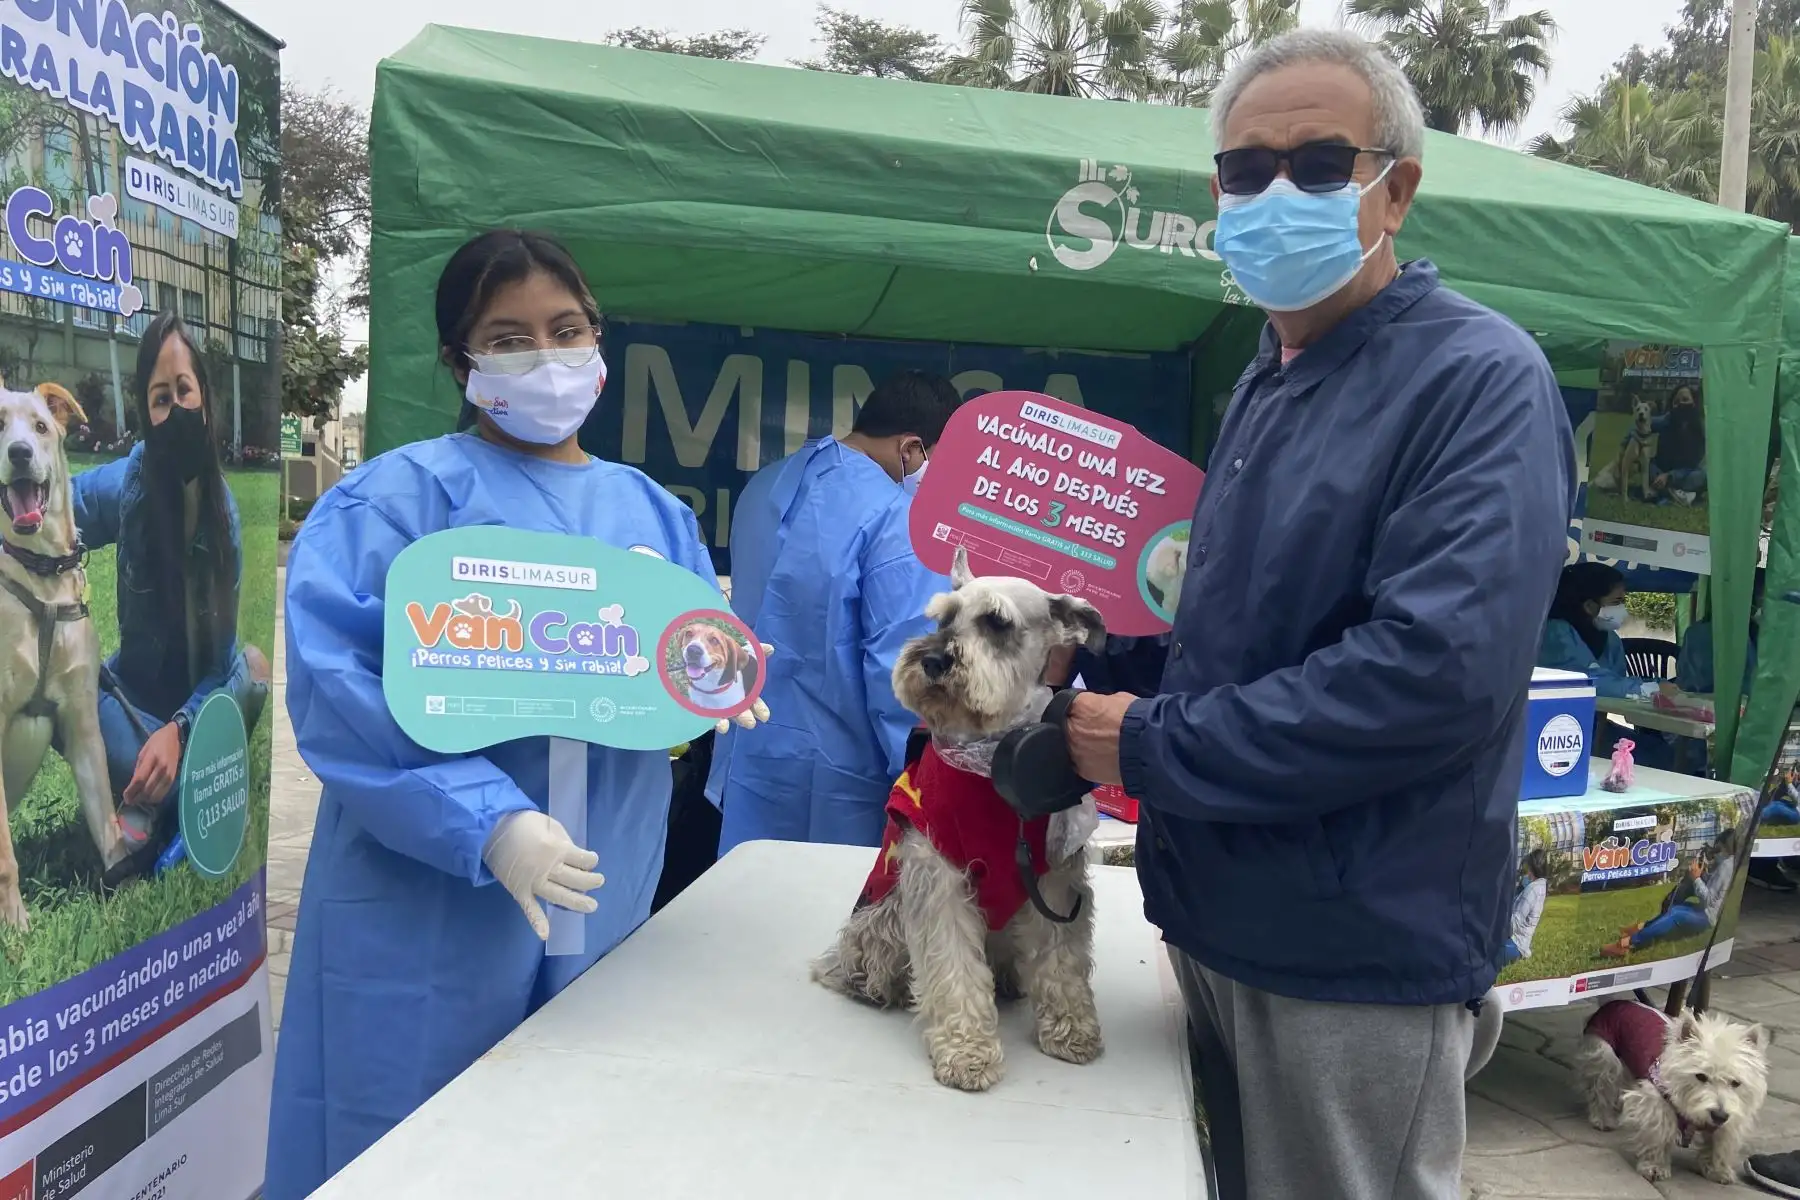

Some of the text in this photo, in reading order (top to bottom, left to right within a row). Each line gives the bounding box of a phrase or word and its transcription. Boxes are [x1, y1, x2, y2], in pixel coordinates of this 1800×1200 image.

[69, 58, 116, 115] LA
[123, 80, 241, 192] RABIA
[7, 187, 132, 283] Can
[71, 282, 116, 309] rabia!
[977, 413, 1166, 495] VACÚNALO UNA VEZ
[977, 446, 1139, 519] AL AÑO DESPUÉS
[973, 476, 1126, 548] DE LOS 3 MESES
[405, 602, 639, 657] Van Can
[412, 649, 470, 667] ¡Perros
[477, 653, 533, 670] felices
[581, 659, 622, 674] rabia!
[1540, 734, 1581, 750] MINSA
[192, 770, 204, 784] Para
[205, 761, 216, 776] más
[213, 765, 239, 792] GRATIS
[205, 788, 245, 827] 113 SALUD
[1583, 839, 1677, 871] Van Can
[56, 949, 178, 1031] vacunándolo
[183, 936, 212, 962] una
[217, 916, 237, 942] vez
[238, 901, 245, 927] al
[49, 1043, 79, 1077] los
[84, 1028, 96, 1055] 3
[102, 996, 159, 1045] meses
[164, 980, 184, 1007] de
[188, 948, 242, 993] nacido.
[155, 1040, 223, 1094] Dirección de Redes
[194, 1067, 204, 1079] de
[205, 1047, 224, 1072] Salud
[155, 1093, 186, 1124] Lima Sur
[42, 1144, 94, 1187] Ministerio
[58, 1164, 86, 1194] Salud
[130, 1154, 187, 1200] ENTENARIO
[148, 1186, 165, 1200] 021
